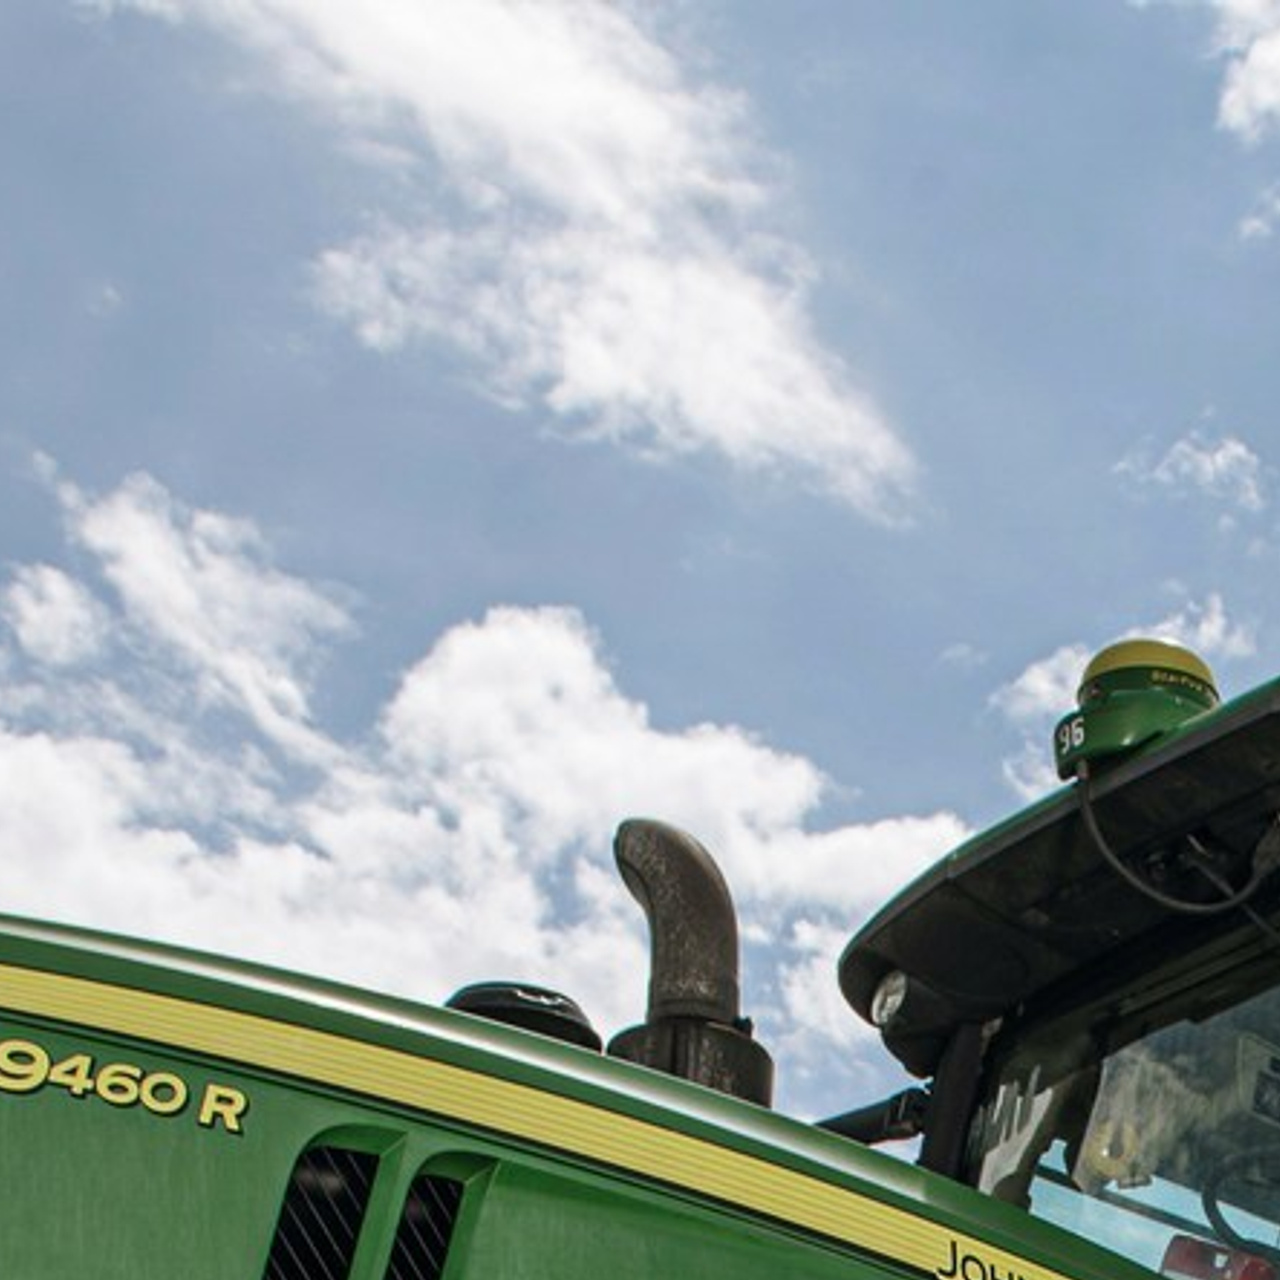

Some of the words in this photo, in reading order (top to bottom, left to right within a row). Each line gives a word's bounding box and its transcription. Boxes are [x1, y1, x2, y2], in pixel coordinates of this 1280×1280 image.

[1057, 715, 1085, 755] 96
[0, 1038, 189, 1114] 9460
[199, 1083, 249, 1133] R
